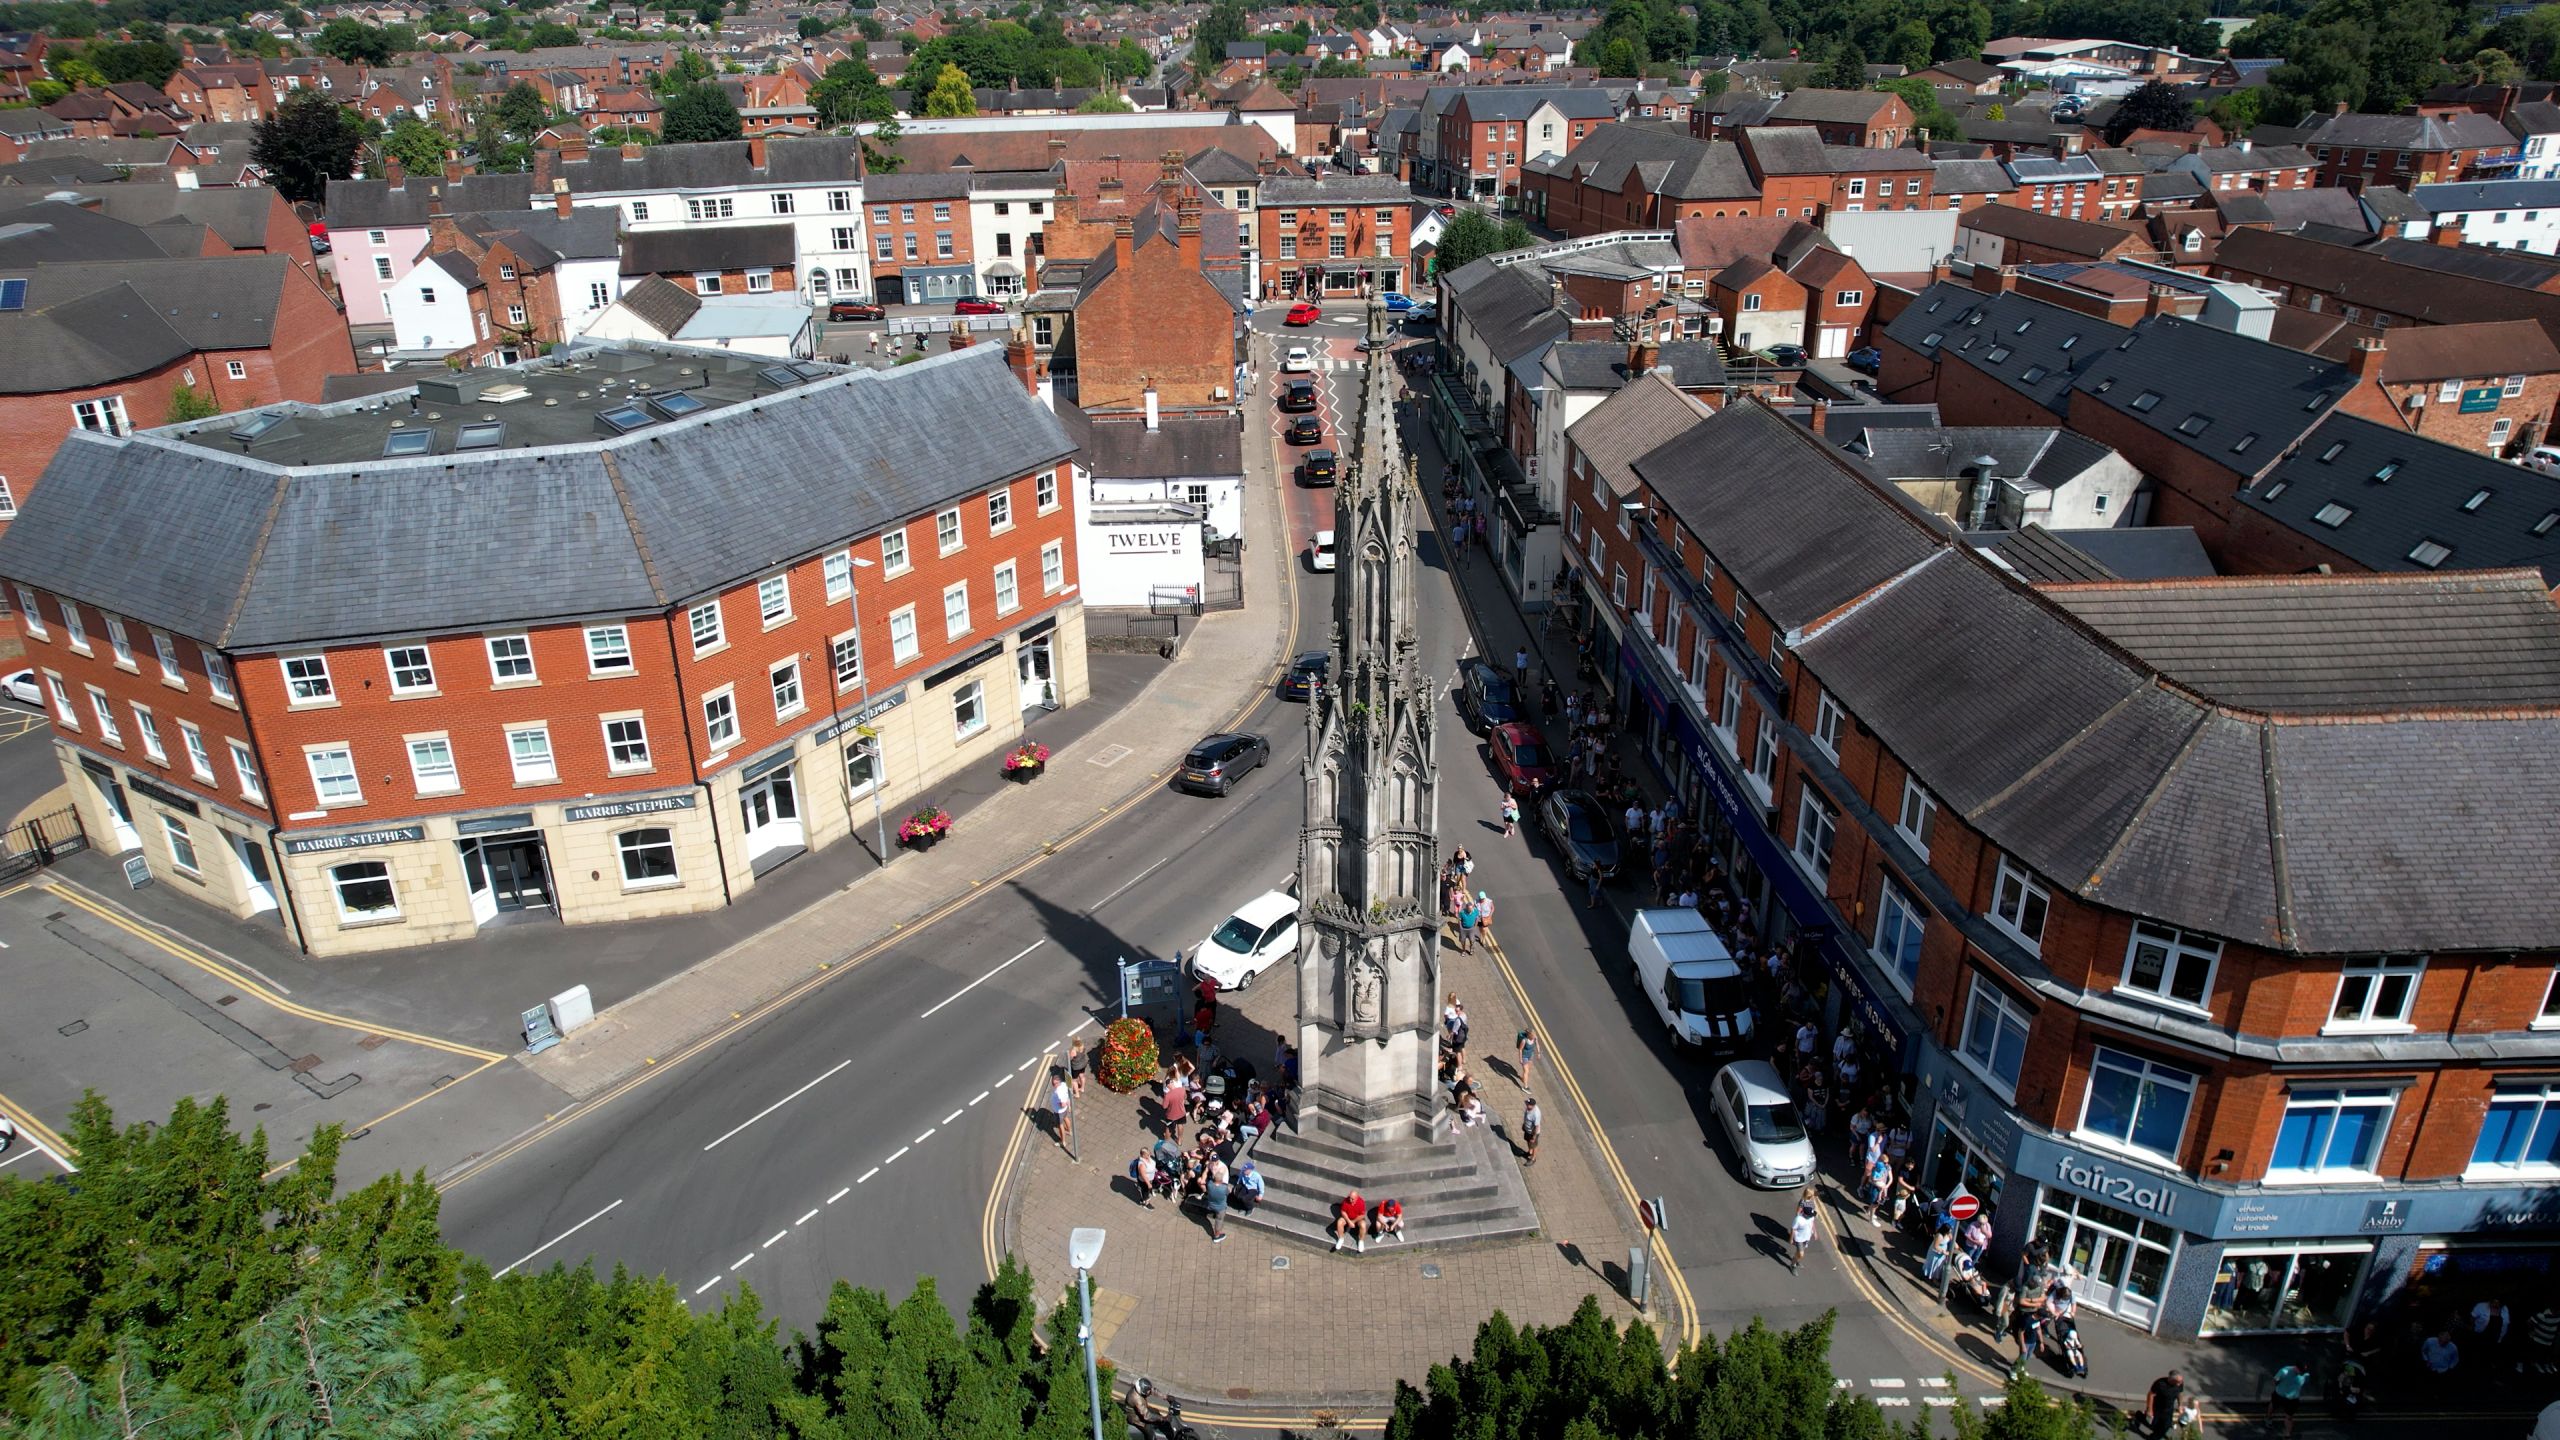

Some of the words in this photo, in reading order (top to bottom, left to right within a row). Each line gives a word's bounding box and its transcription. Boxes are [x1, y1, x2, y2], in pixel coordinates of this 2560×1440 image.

[1108, 533, 1181, 547] TWELVE
[827, 717, 860, 739] BARRIE
[859, 696, 898, 723] SEPHEN
[1717, 775, 1739, 816] Hospice
[575, 804, 624, 819] BARRIE
[625, 797, 687, 814] STEPHEN
[296, 836, 348, 852] BARRIE
[350, 829, 414, 846] STEPHEN
[1864, 1000, 1898, 1052] HOUSE
[2058, 1155, 2178, 1217] fair2all
[2235, 1213, 2279, 1222] sustainable
[2238, 1204, 2265, 1213] ethical
[2232, 1224, 2247, 1232] fair
[2247, 1223, 2270, 1231] trade
[2365, 1216, 2405, 1229] Ashby
